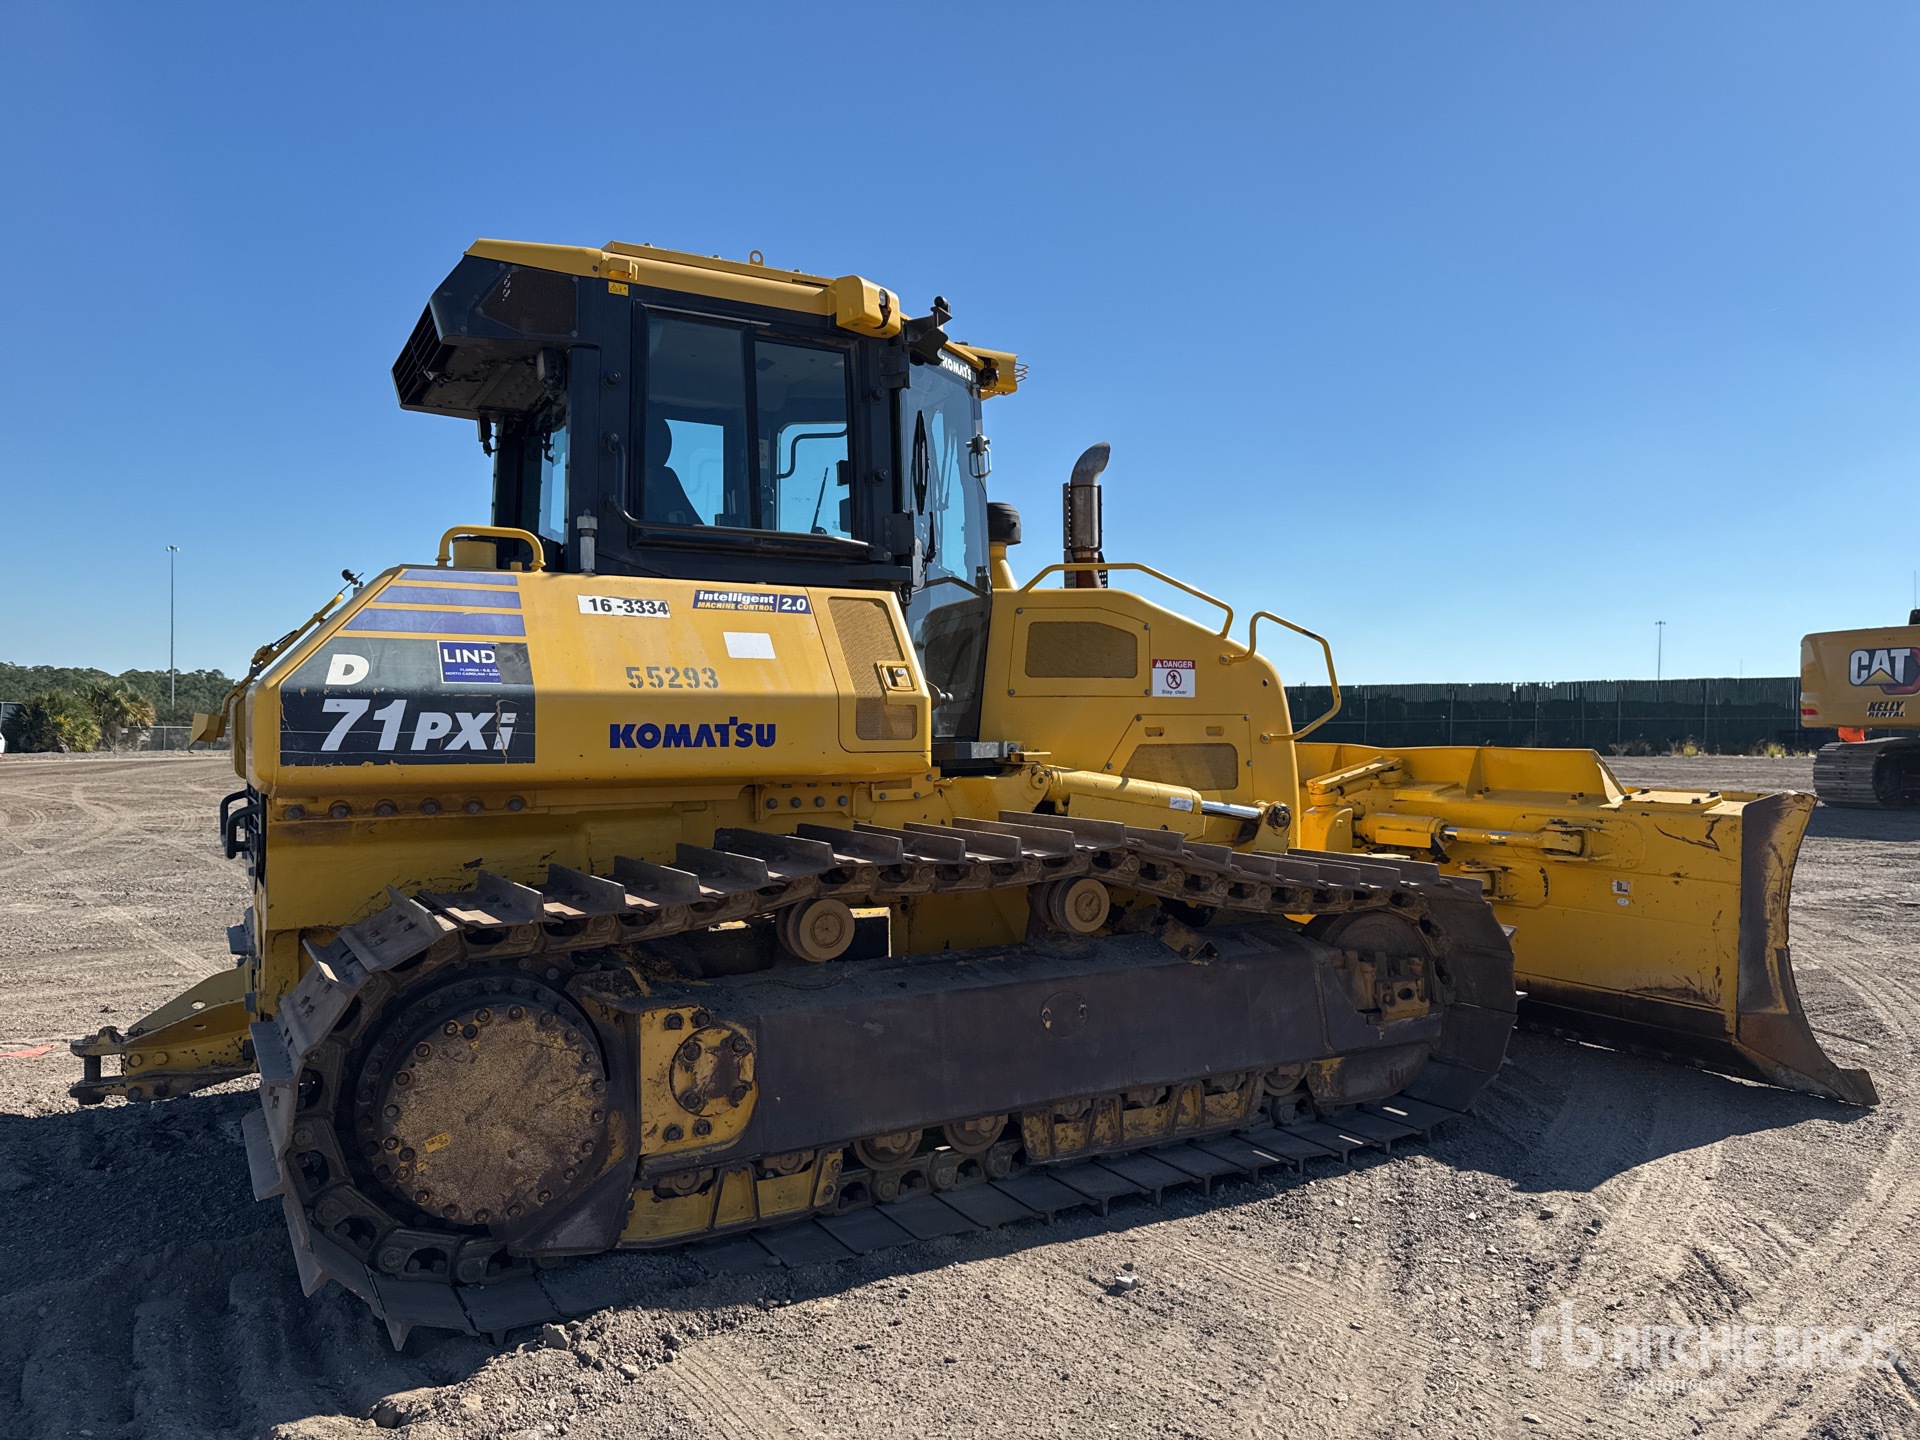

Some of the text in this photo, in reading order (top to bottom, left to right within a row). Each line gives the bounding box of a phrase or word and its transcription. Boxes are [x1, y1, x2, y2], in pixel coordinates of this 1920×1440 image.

[699, 591, 774, 605] intelligent
[781, 598, 807, 611] 2.0
[589, 598, 668, 615] 16-3334
[697, 601, 774, 612] MACHINE CONTROL
[443, 648, 496, 664] LIND
[1162, 660, 1193, 668] DANGER
[325, 653, 370, 685] D
[1850, 648, 1911, 685] CAT
[626, 667, 719, 689] 55293
[1867, 701, 1904, 712] KELLY
[609, 716, 777, 749] KOMATSU
